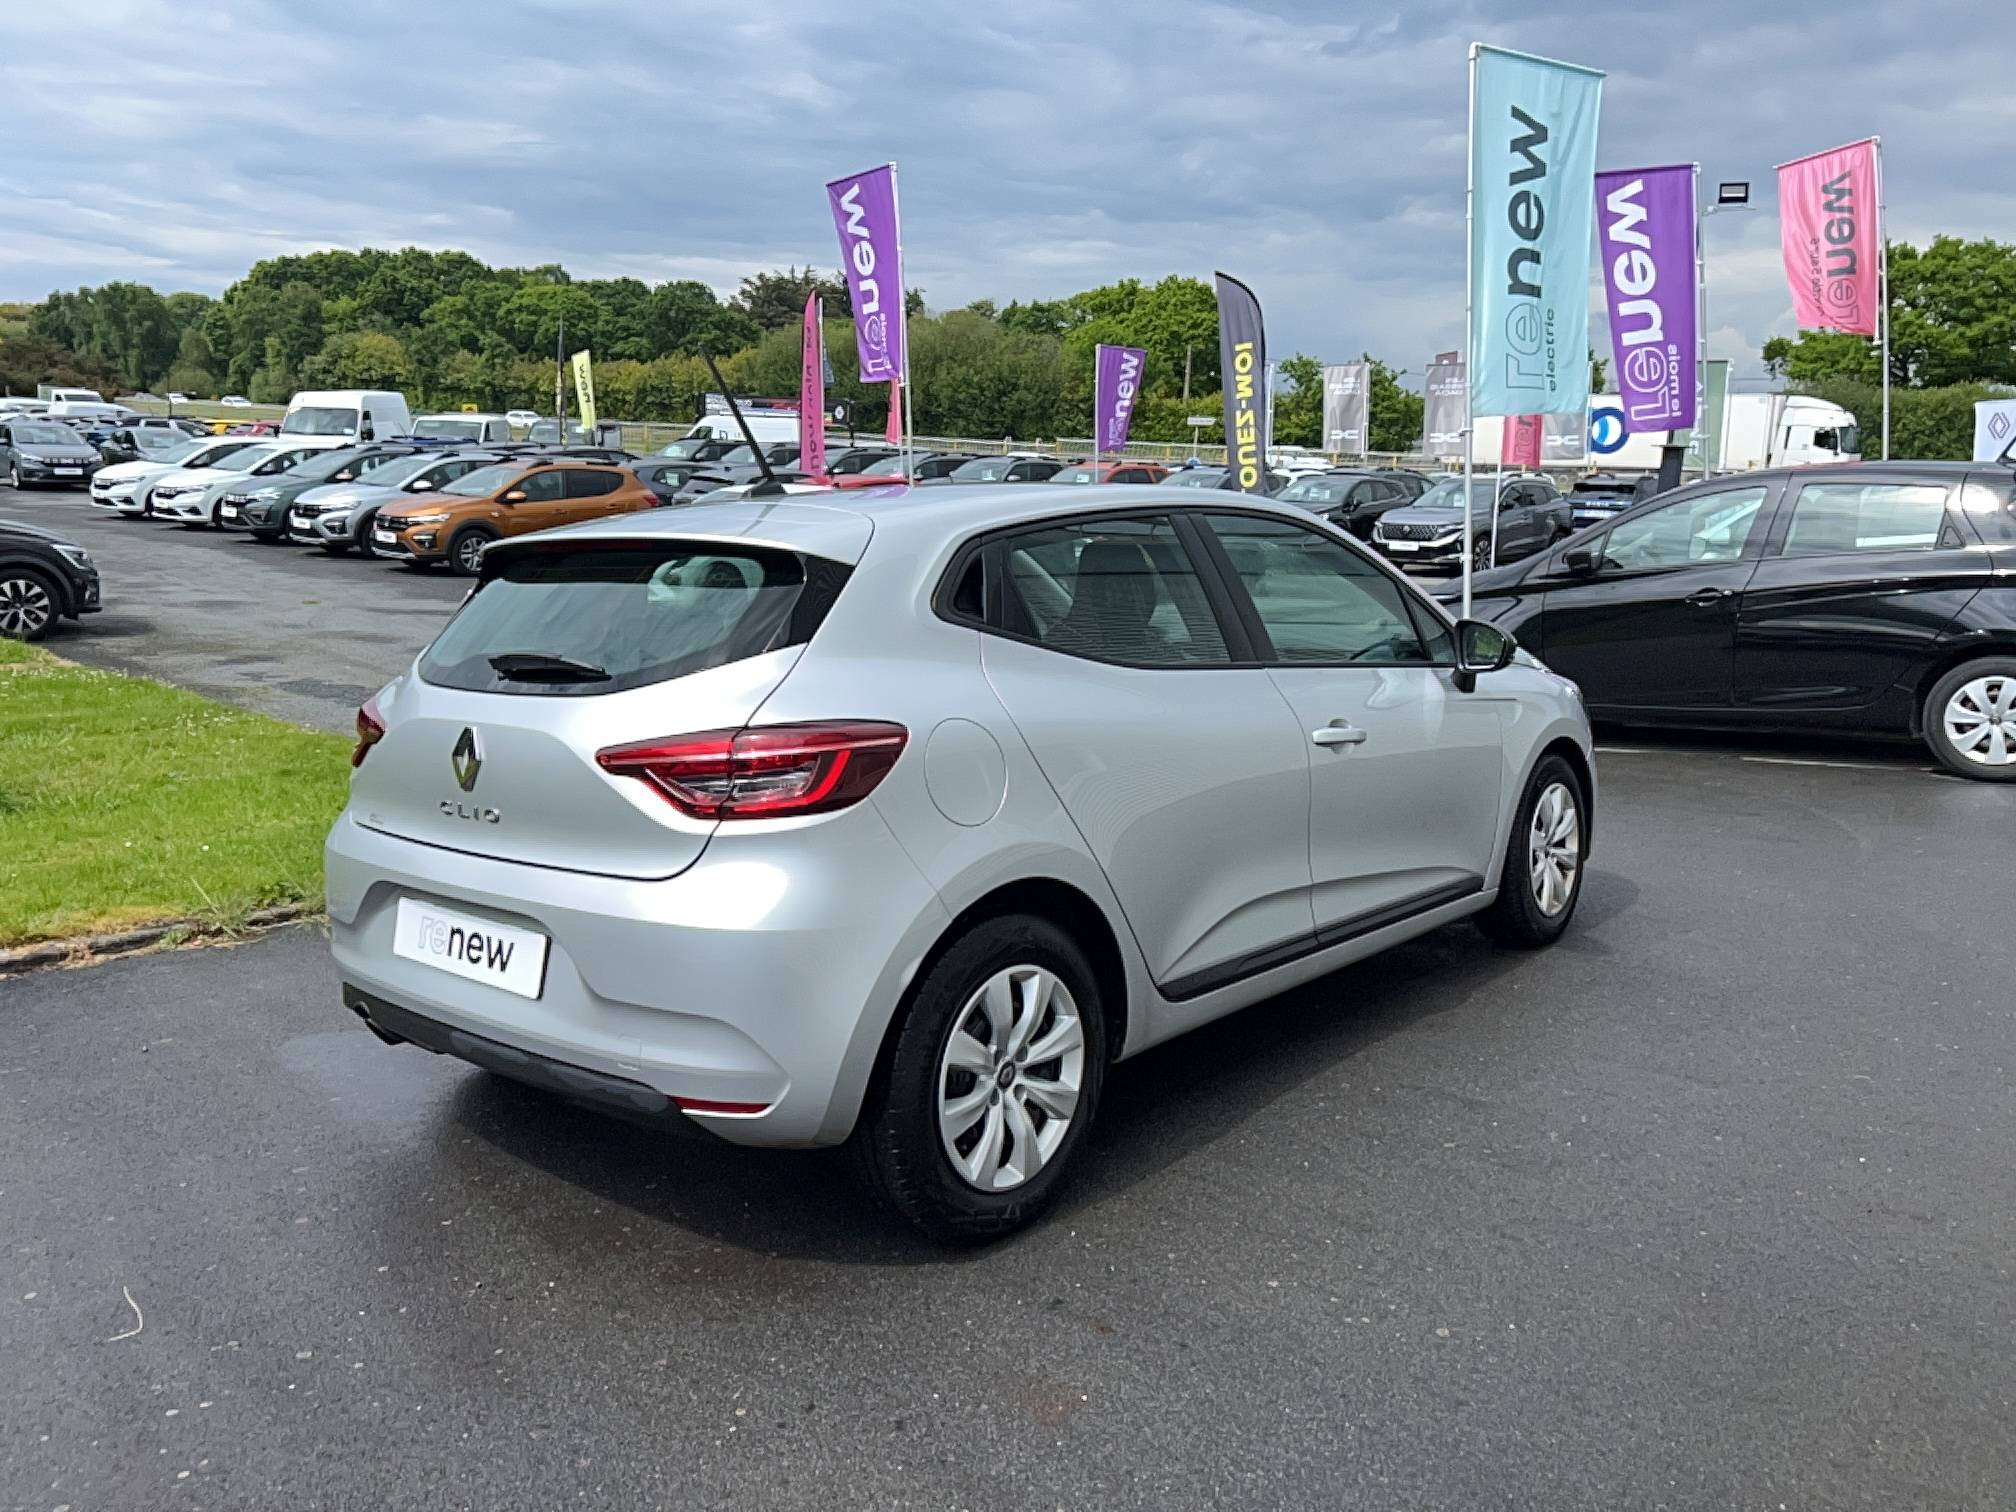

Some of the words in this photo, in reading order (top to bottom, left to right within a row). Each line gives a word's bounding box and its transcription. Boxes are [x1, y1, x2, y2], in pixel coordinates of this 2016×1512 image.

[1505, 104, 1549, 391] renew
[1546, 308, 1557, 392] electric
[440, 800, 501, 824] CLIO
[417, 915, 515, 972] renew
